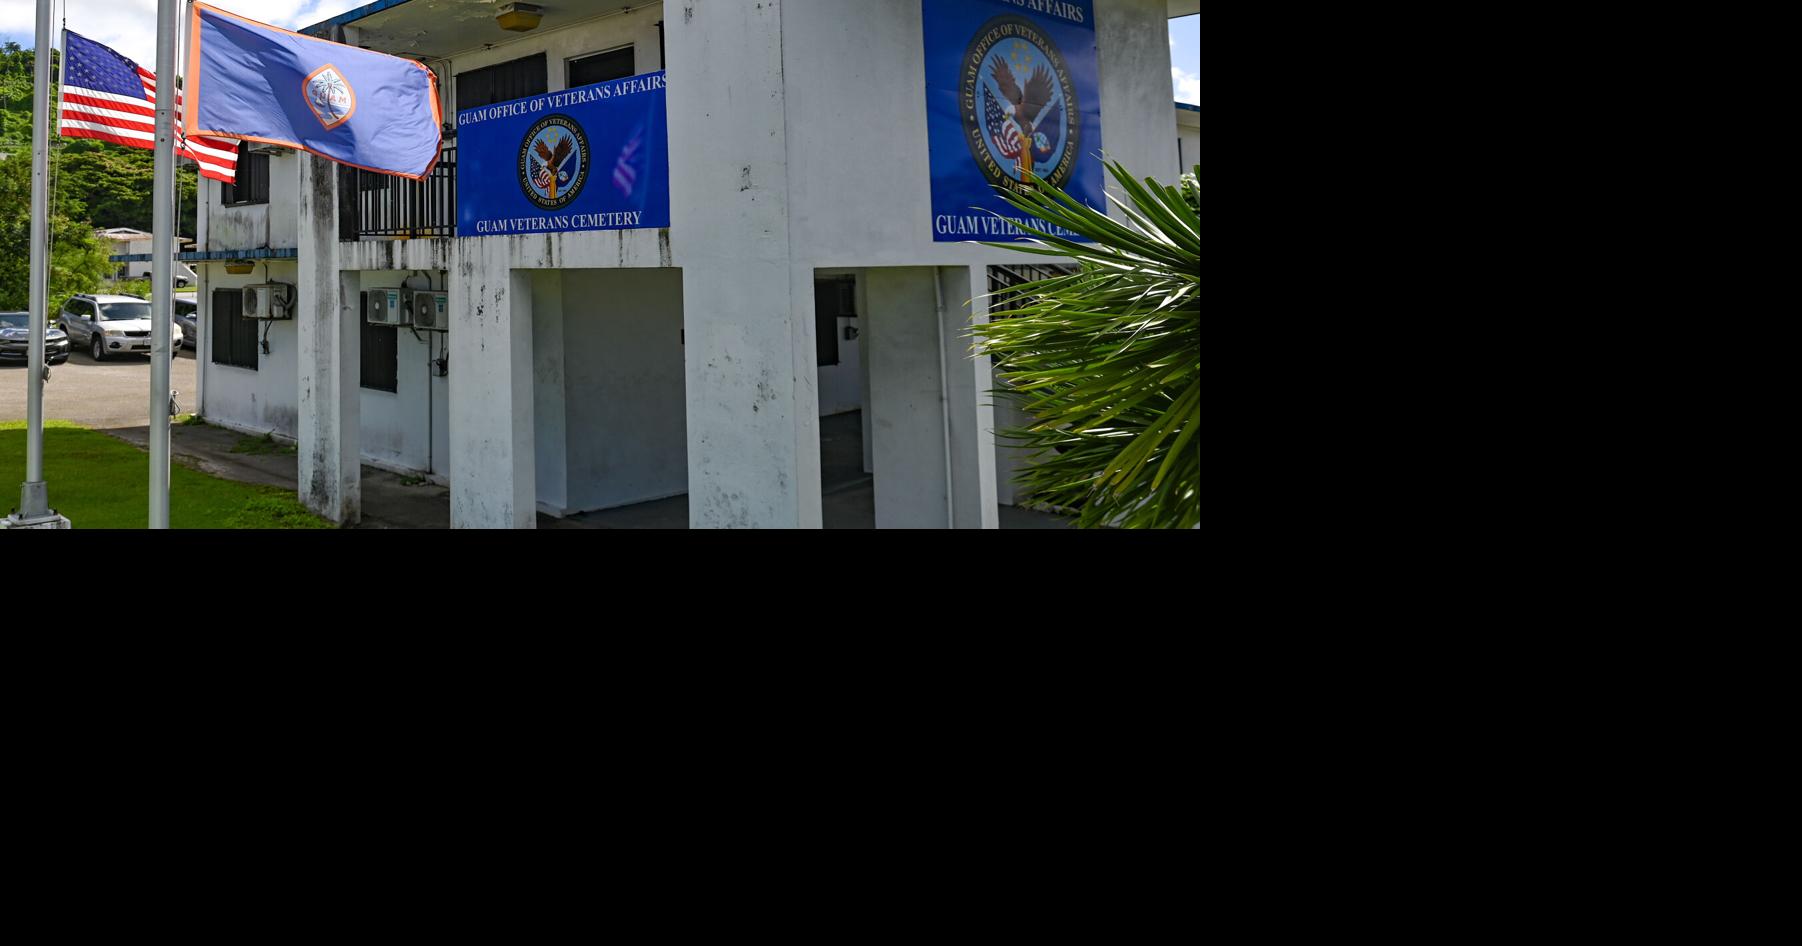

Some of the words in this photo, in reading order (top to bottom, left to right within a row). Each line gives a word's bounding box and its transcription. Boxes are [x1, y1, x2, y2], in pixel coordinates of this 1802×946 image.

[1027, 0, 1084, 23] AFFAIRS
[965, 65, 977, 110] GUAM
[972, 27, 1000, 64] OFFICE
[1000, 23, 1014, 35] OF
[1013, 24, 1059, 68] VETERANS
[458, 110, 487, 126] GUAM
[489, 102, 527, 120] OFFICE
[530, 98, 545, 112] OF
[547, 85, 611, 108] VETERANS
[613, 74, 667, 97] AFFAIRS
[972, 128, 1000, 178] UNITED
[1051, 141, 1074, 185] AMERICA
[476, 219, 507, 232] GUAM
[510, 215, 569, 231] VETERANS
[571, 210, 642, 228] CEMETERY
[936, 214, 979, 234] GUAM
